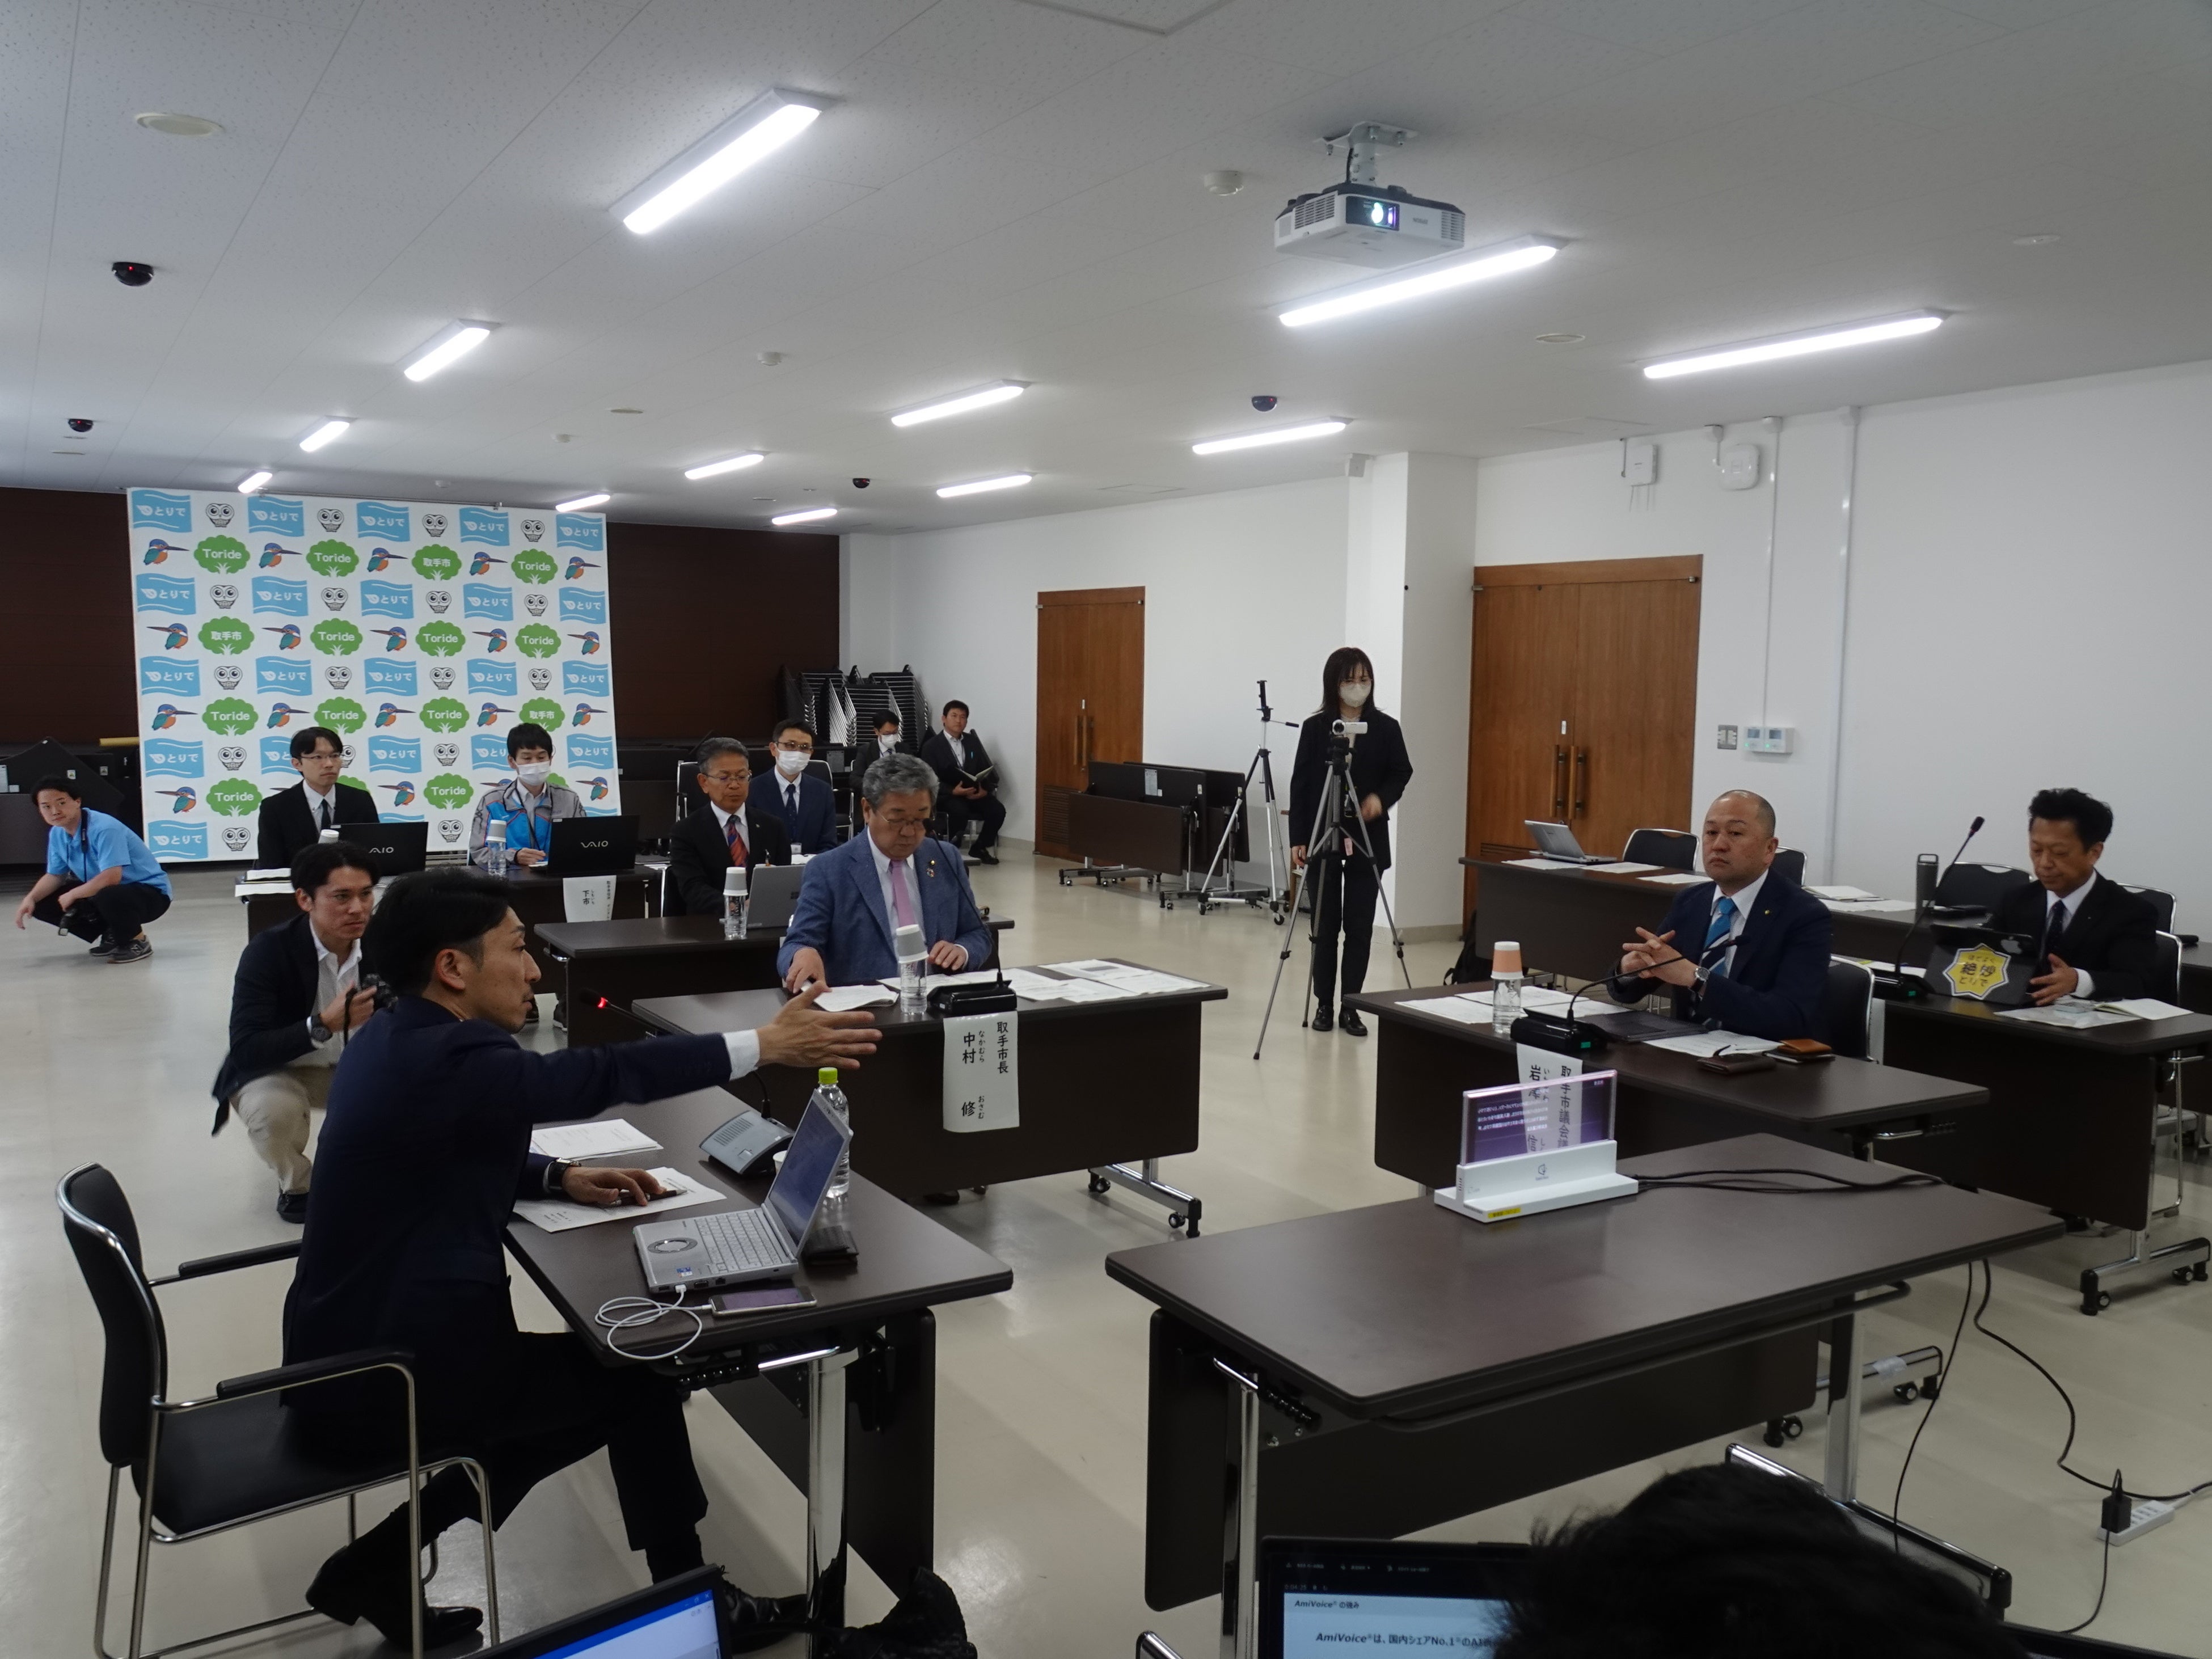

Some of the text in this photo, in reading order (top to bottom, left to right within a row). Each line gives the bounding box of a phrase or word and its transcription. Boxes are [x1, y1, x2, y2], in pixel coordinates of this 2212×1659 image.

[154, 507, 185, 516] とりで
[269, 513, 298, 521] とりで
[377, 518, 404, 526] とりで
[479, 523, 504, 531] とりで
[573, 528, 599, 537] とりで
[202, 548, 242, 559] Toride
[314, 552, 351, 563] Toride
[423, 558, 451, 567] 取手市
[518, 561, 551, 571] Toride
[159, 590, 189, 599] とりで
[273, 593, 303, 601] とりで
[381, 596, 408, 604] とりで
[211, 631, 242, 640] 取手市
[318, 631, 355, 641] Toride
[423, 633, 458, 643] Toride
[522, 635, 554, 645] Toride
[163, 672, 194, 681] とりで
[277, 672, 306, 681] とりで
[385, 673, 412, 681] とりで
[486, 673, 512, 681] とりで
[210, 711, 251, 721] Toride
[322, 710, 359, 720] Toride
[427, 710, 462, 719] Toride
[529, 711, 554, 719] 取手市
[388, 750, 416, 758] とりで
[584, 748, 609, 756] とりで
[167, 754, 199, 763] とりで
[430, 786, 466, 795] Toride
[214, 792, 254, 801] Toride
[171, 835, 202, 845] とりで
[582, 890, 590, 905] 下市
[997, 1021, 1009, 1074] 取手市長
[961, 1032, 976, 1117] 中村 修
